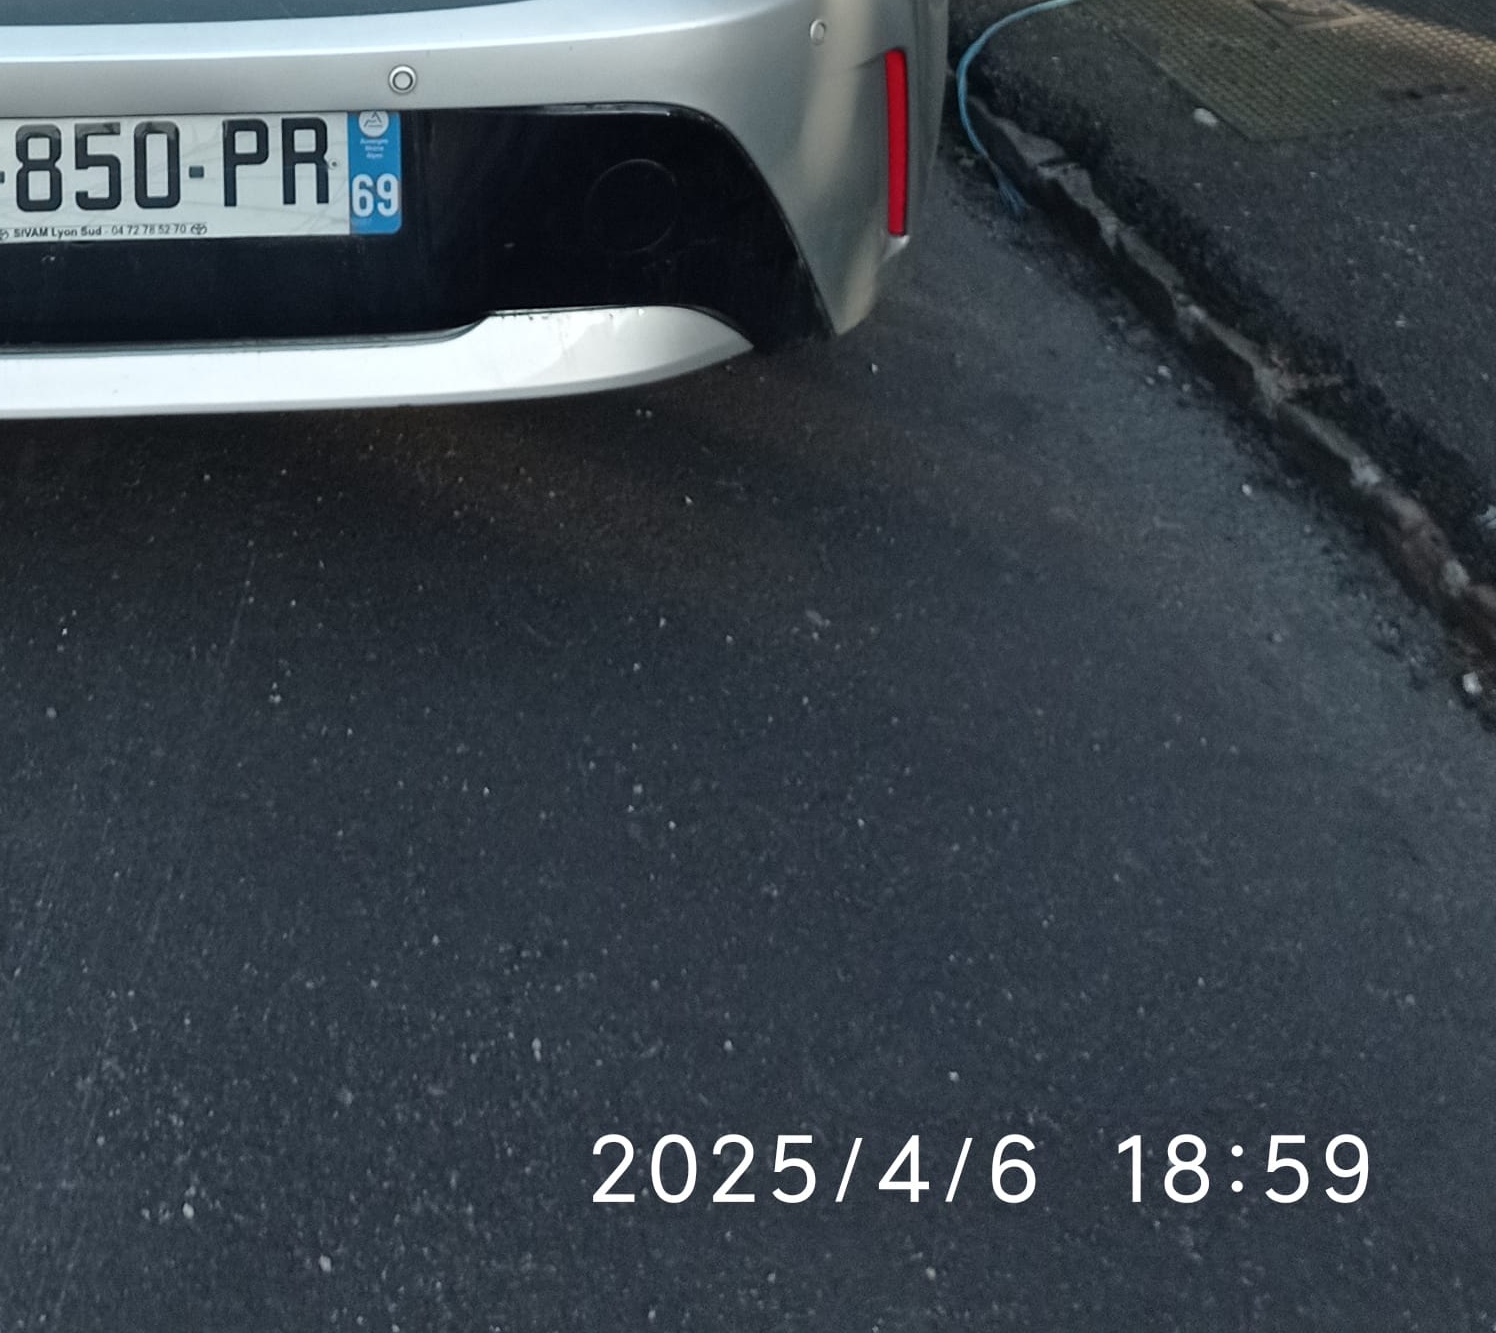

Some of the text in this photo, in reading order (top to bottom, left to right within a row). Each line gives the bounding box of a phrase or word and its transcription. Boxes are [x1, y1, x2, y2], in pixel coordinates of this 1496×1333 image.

[352, 173, 399, 217] 69
[14, 227, 48, 238] SIVAM
[52, 227, 78, 239] Lyon
[81, 226, 102, 236] Sud
